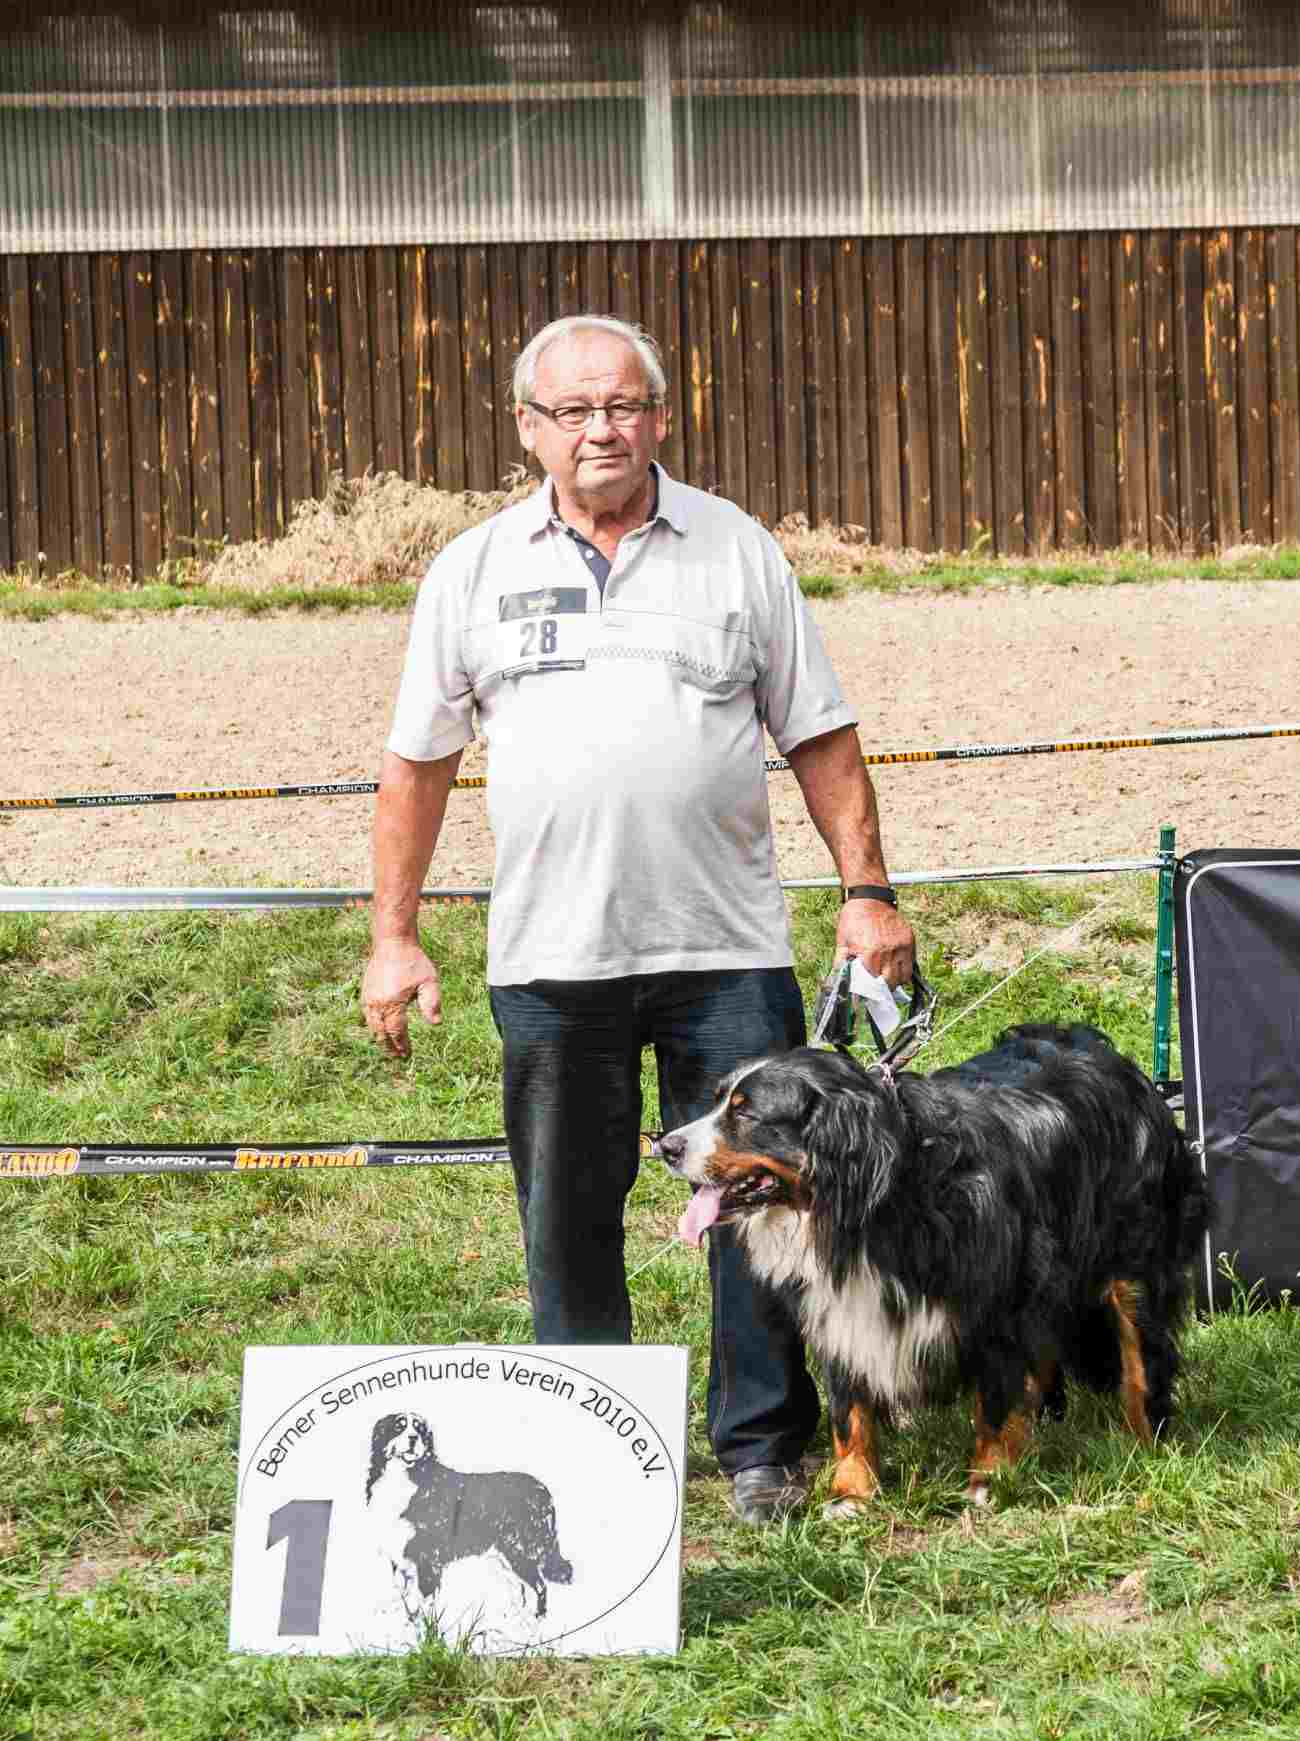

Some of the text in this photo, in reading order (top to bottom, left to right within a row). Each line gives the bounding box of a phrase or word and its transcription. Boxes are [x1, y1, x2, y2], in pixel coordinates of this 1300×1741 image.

[519, 619, 558, 658] 28
[298, 783, 376, 797] CHAMPION
[105, 1155, 206, 1166] CHAMPION
[393, 1152, 495, 1164] CHAMPION
[256, 1357, 666, 1480] Berner Sennenhunde Verein 2010 e.V.
[265, 1499, 334, 1637] 1
